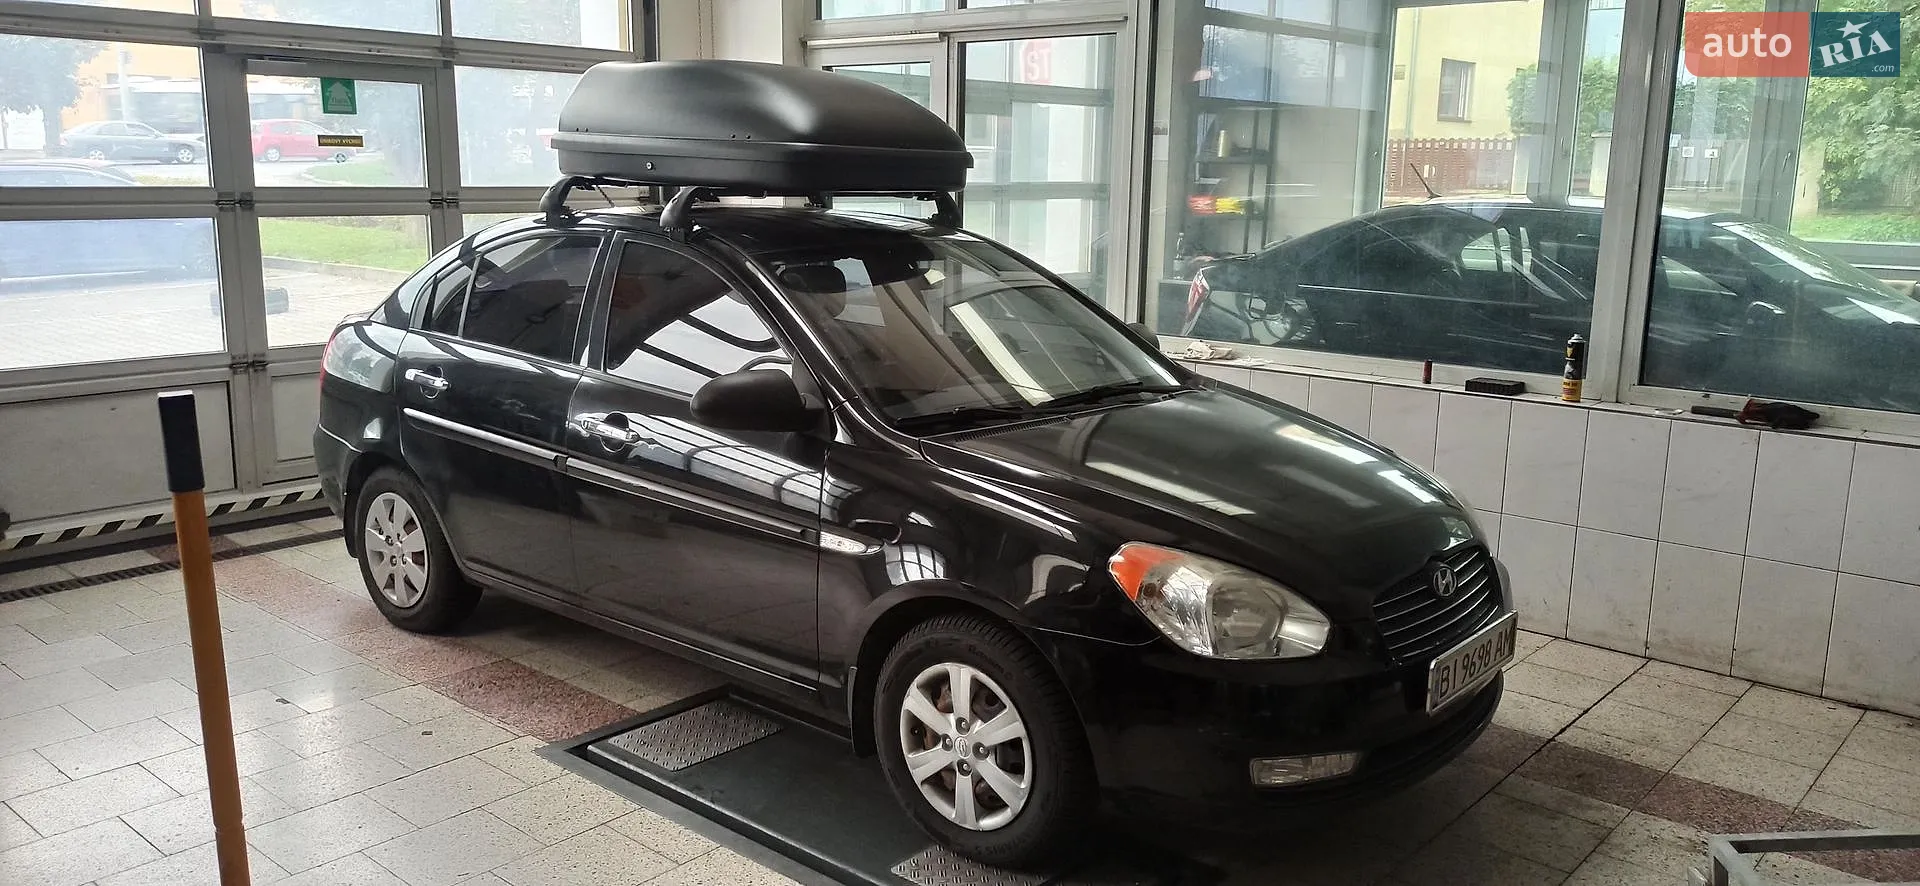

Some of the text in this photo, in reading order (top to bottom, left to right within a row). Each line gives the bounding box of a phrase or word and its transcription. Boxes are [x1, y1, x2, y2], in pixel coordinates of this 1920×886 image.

[1440, 622, 1516, 698] BI 9698 AM
